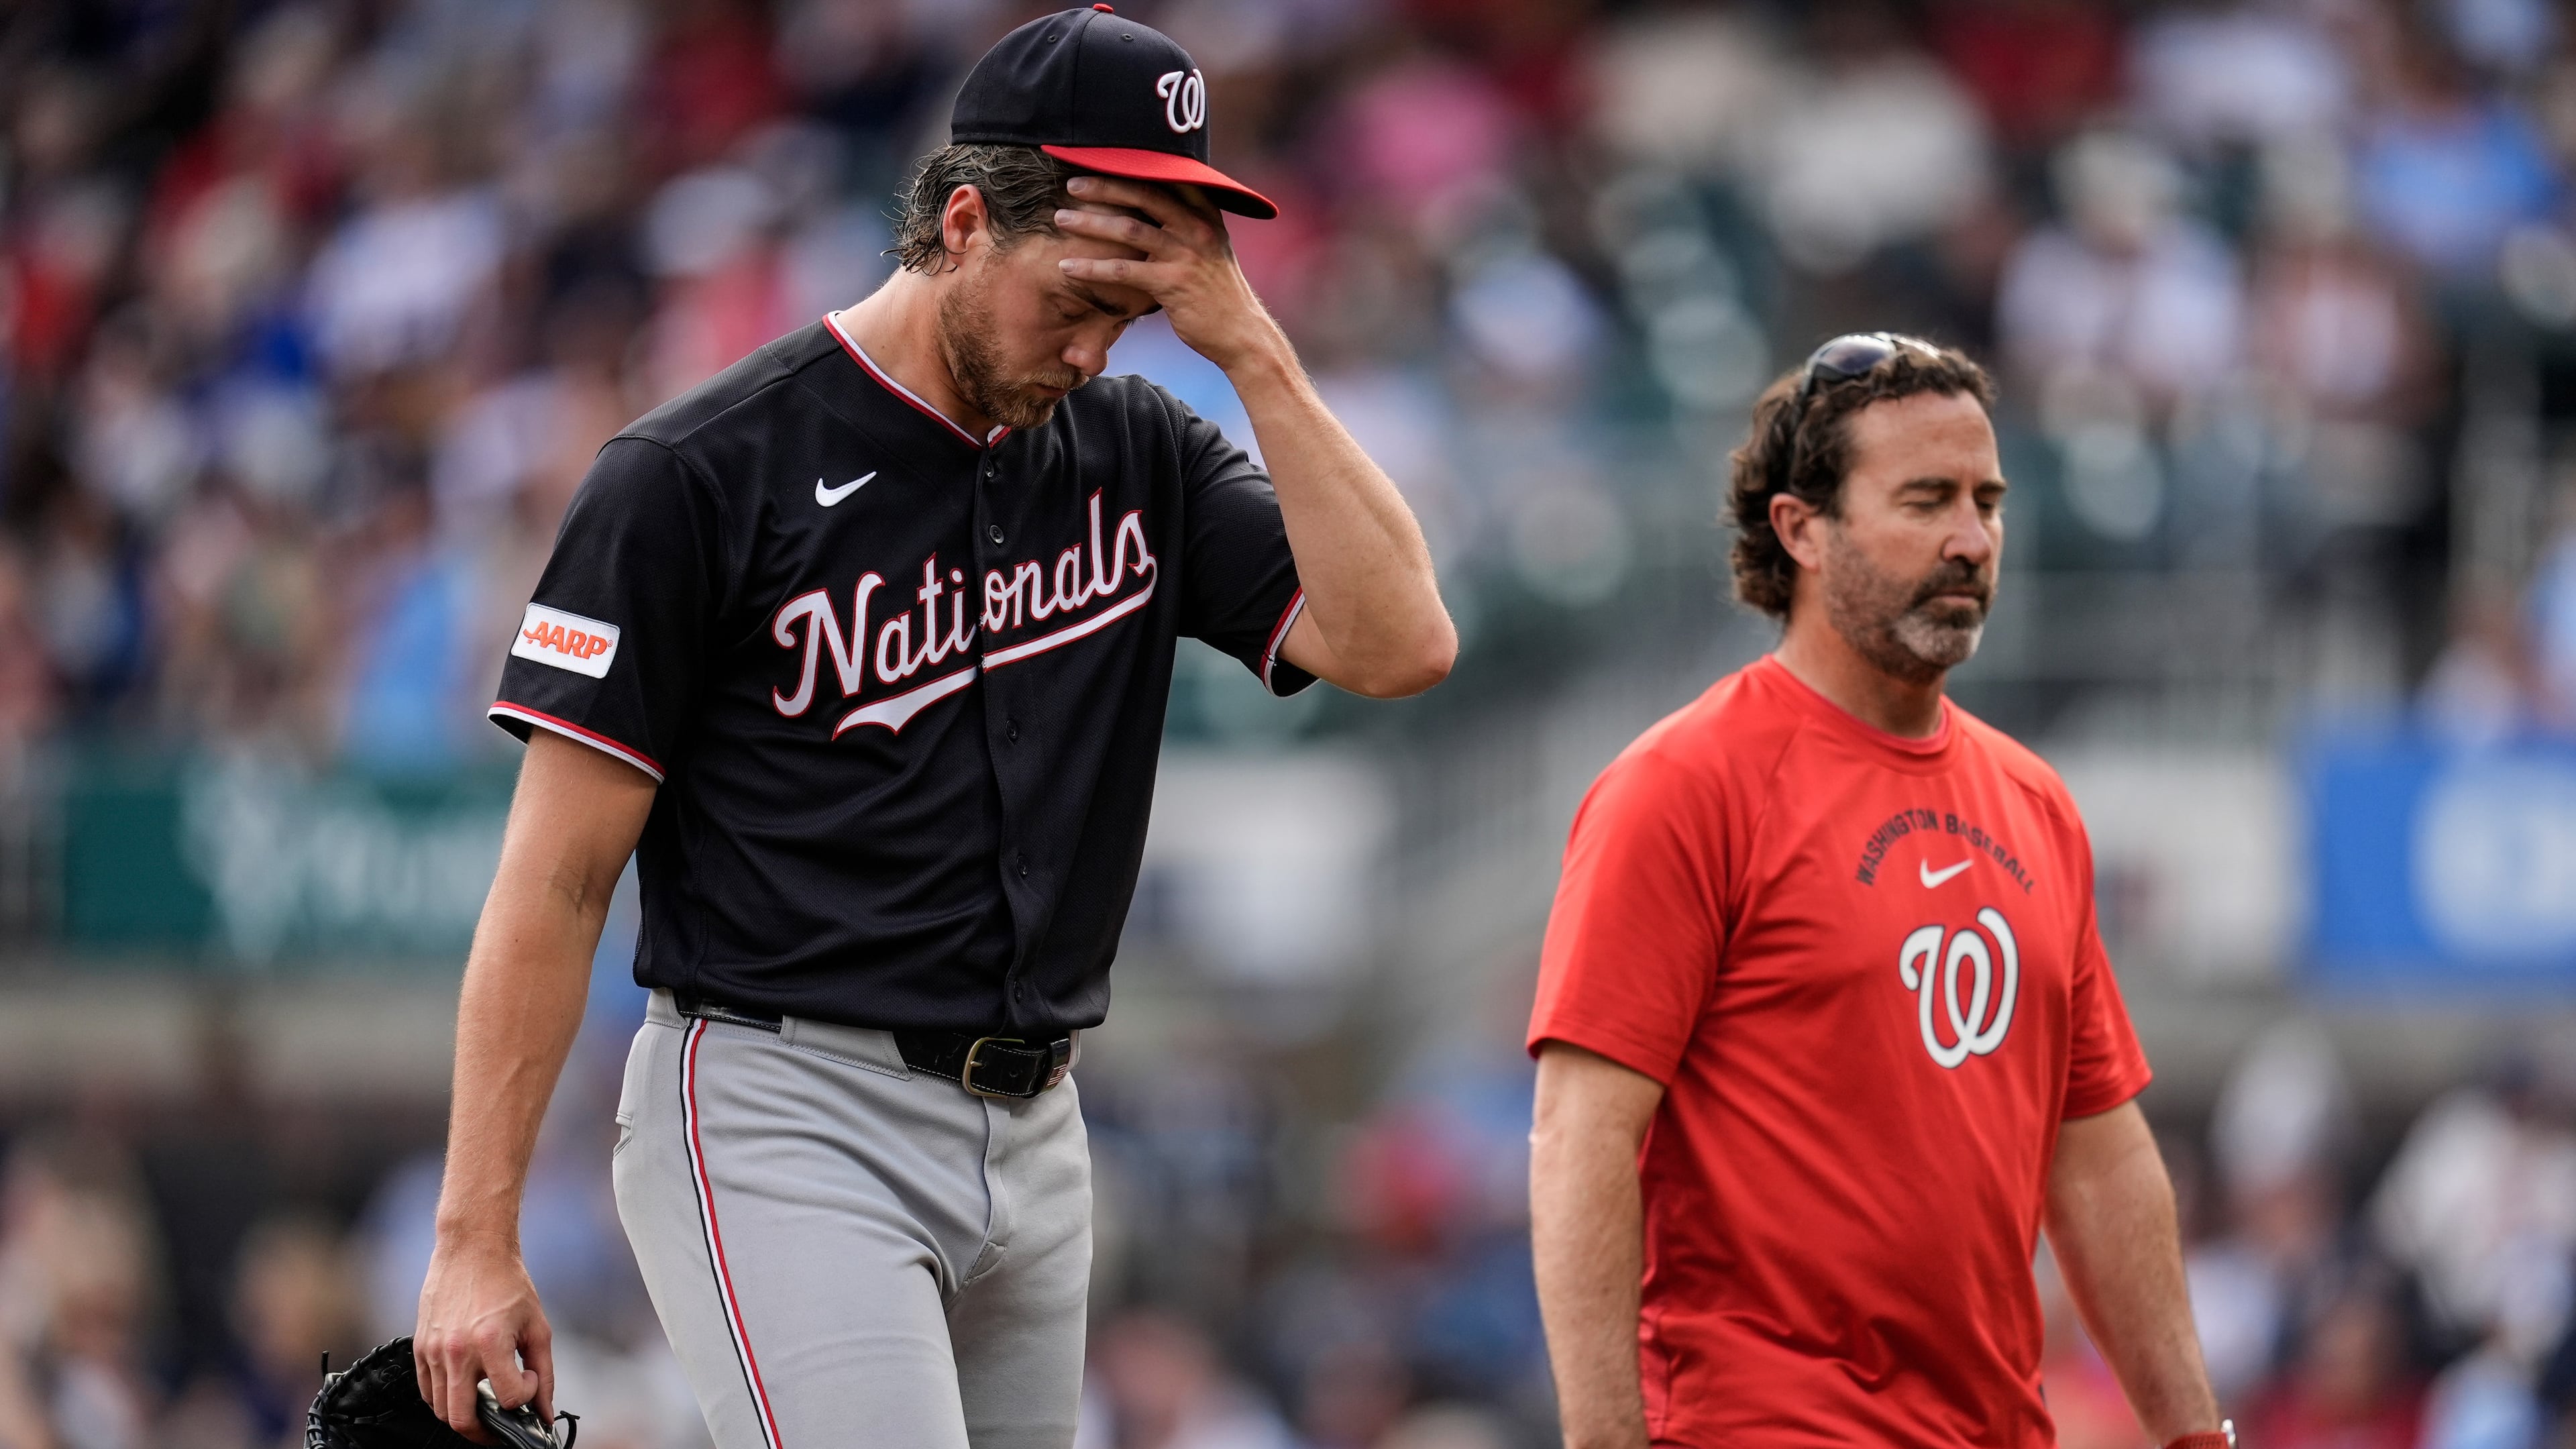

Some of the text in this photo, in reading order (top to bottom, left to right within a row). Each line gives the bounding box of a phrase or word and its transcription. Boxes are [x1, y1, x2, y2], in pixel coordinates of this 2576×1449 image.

[1156, 68, 1205, 133] W
[772, 487, 1157, 718] Nationals
[1855, 808, 2035, 895] WASHINGTON BASEBALL
[1898, 906, 2020, 1069] W
